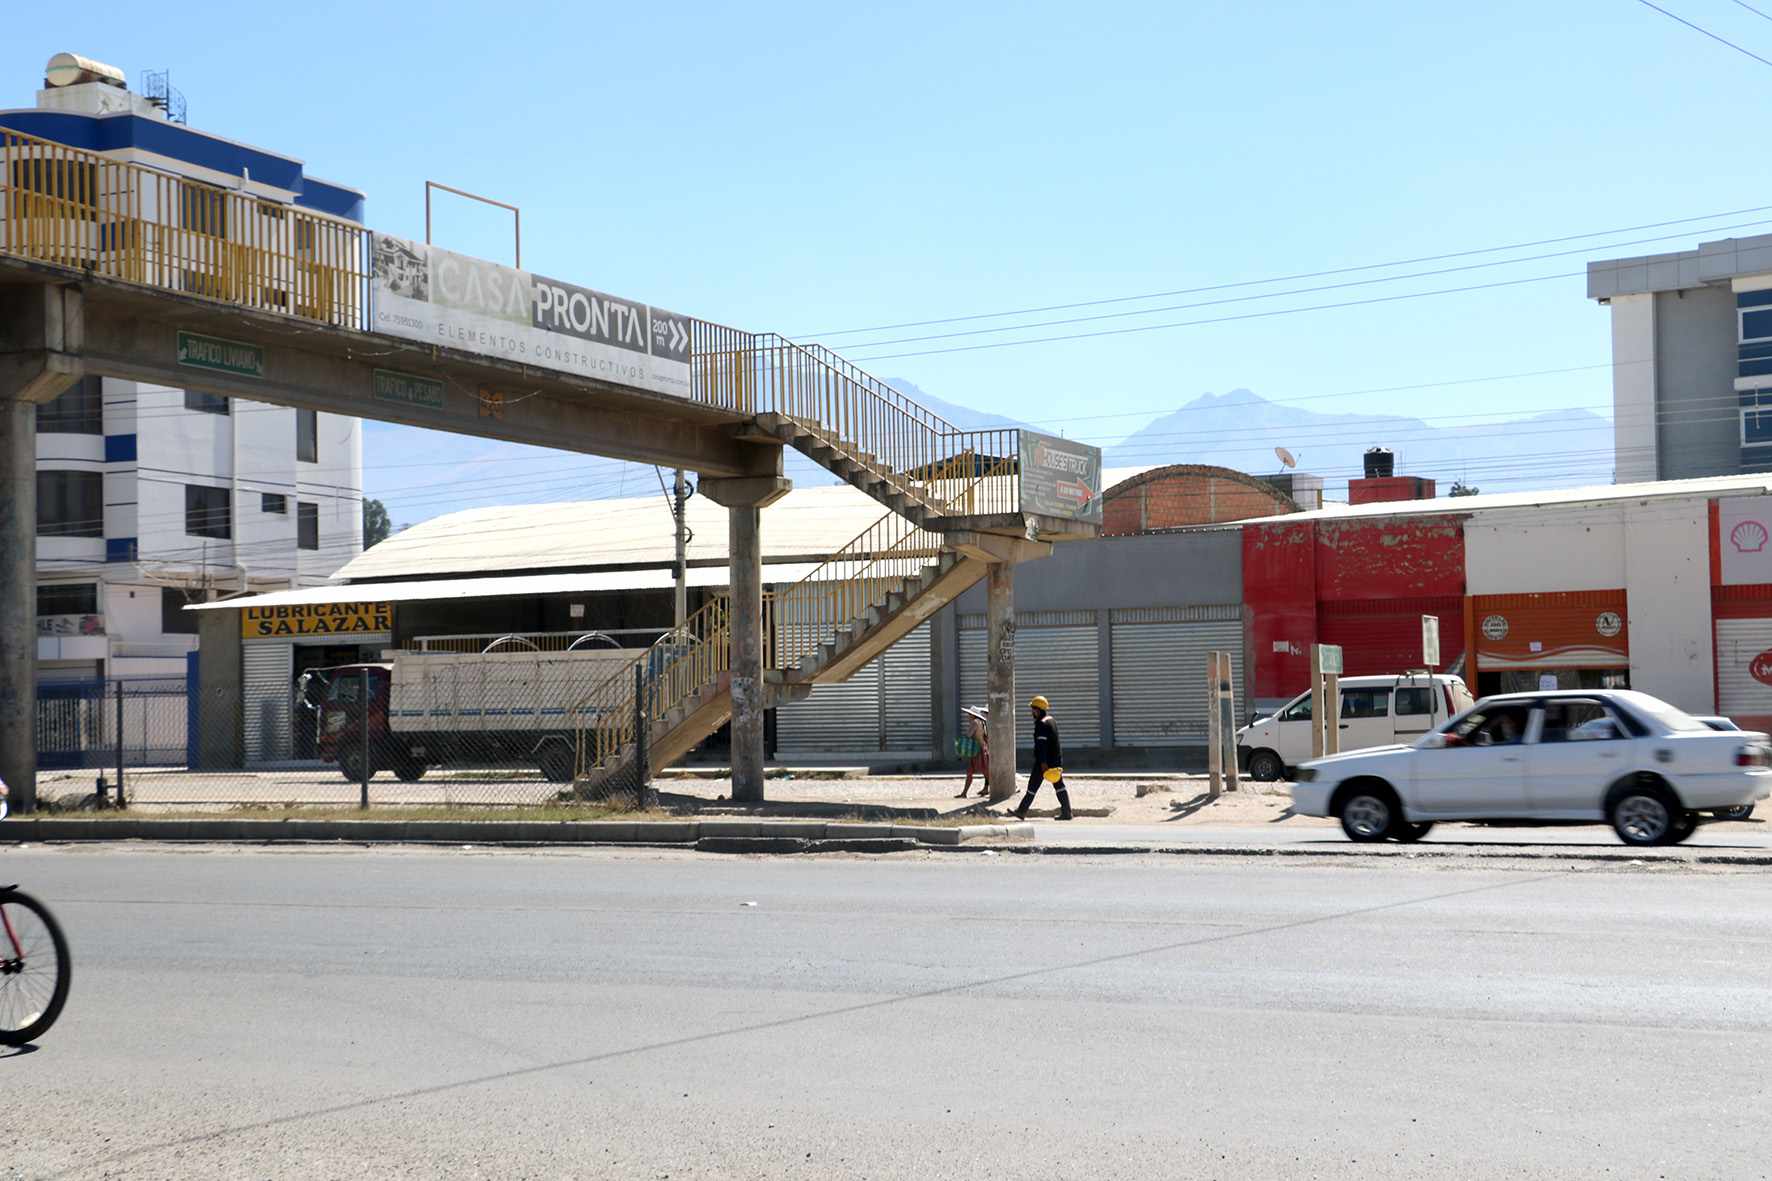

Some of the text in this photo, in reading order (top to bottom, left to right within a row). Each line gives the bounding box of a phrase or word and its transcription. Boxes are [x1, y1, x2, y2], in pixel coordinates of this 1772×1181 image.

[438, 257, 644, 347] CASA PRONTA
[653, 319, 668, 335] 200
[438, 323, 526, 353] ELEMENTOS
[536, 344, 645, 380] CONSTRUCTIVOS
[257, 616, 391, 635] SALAZAR
